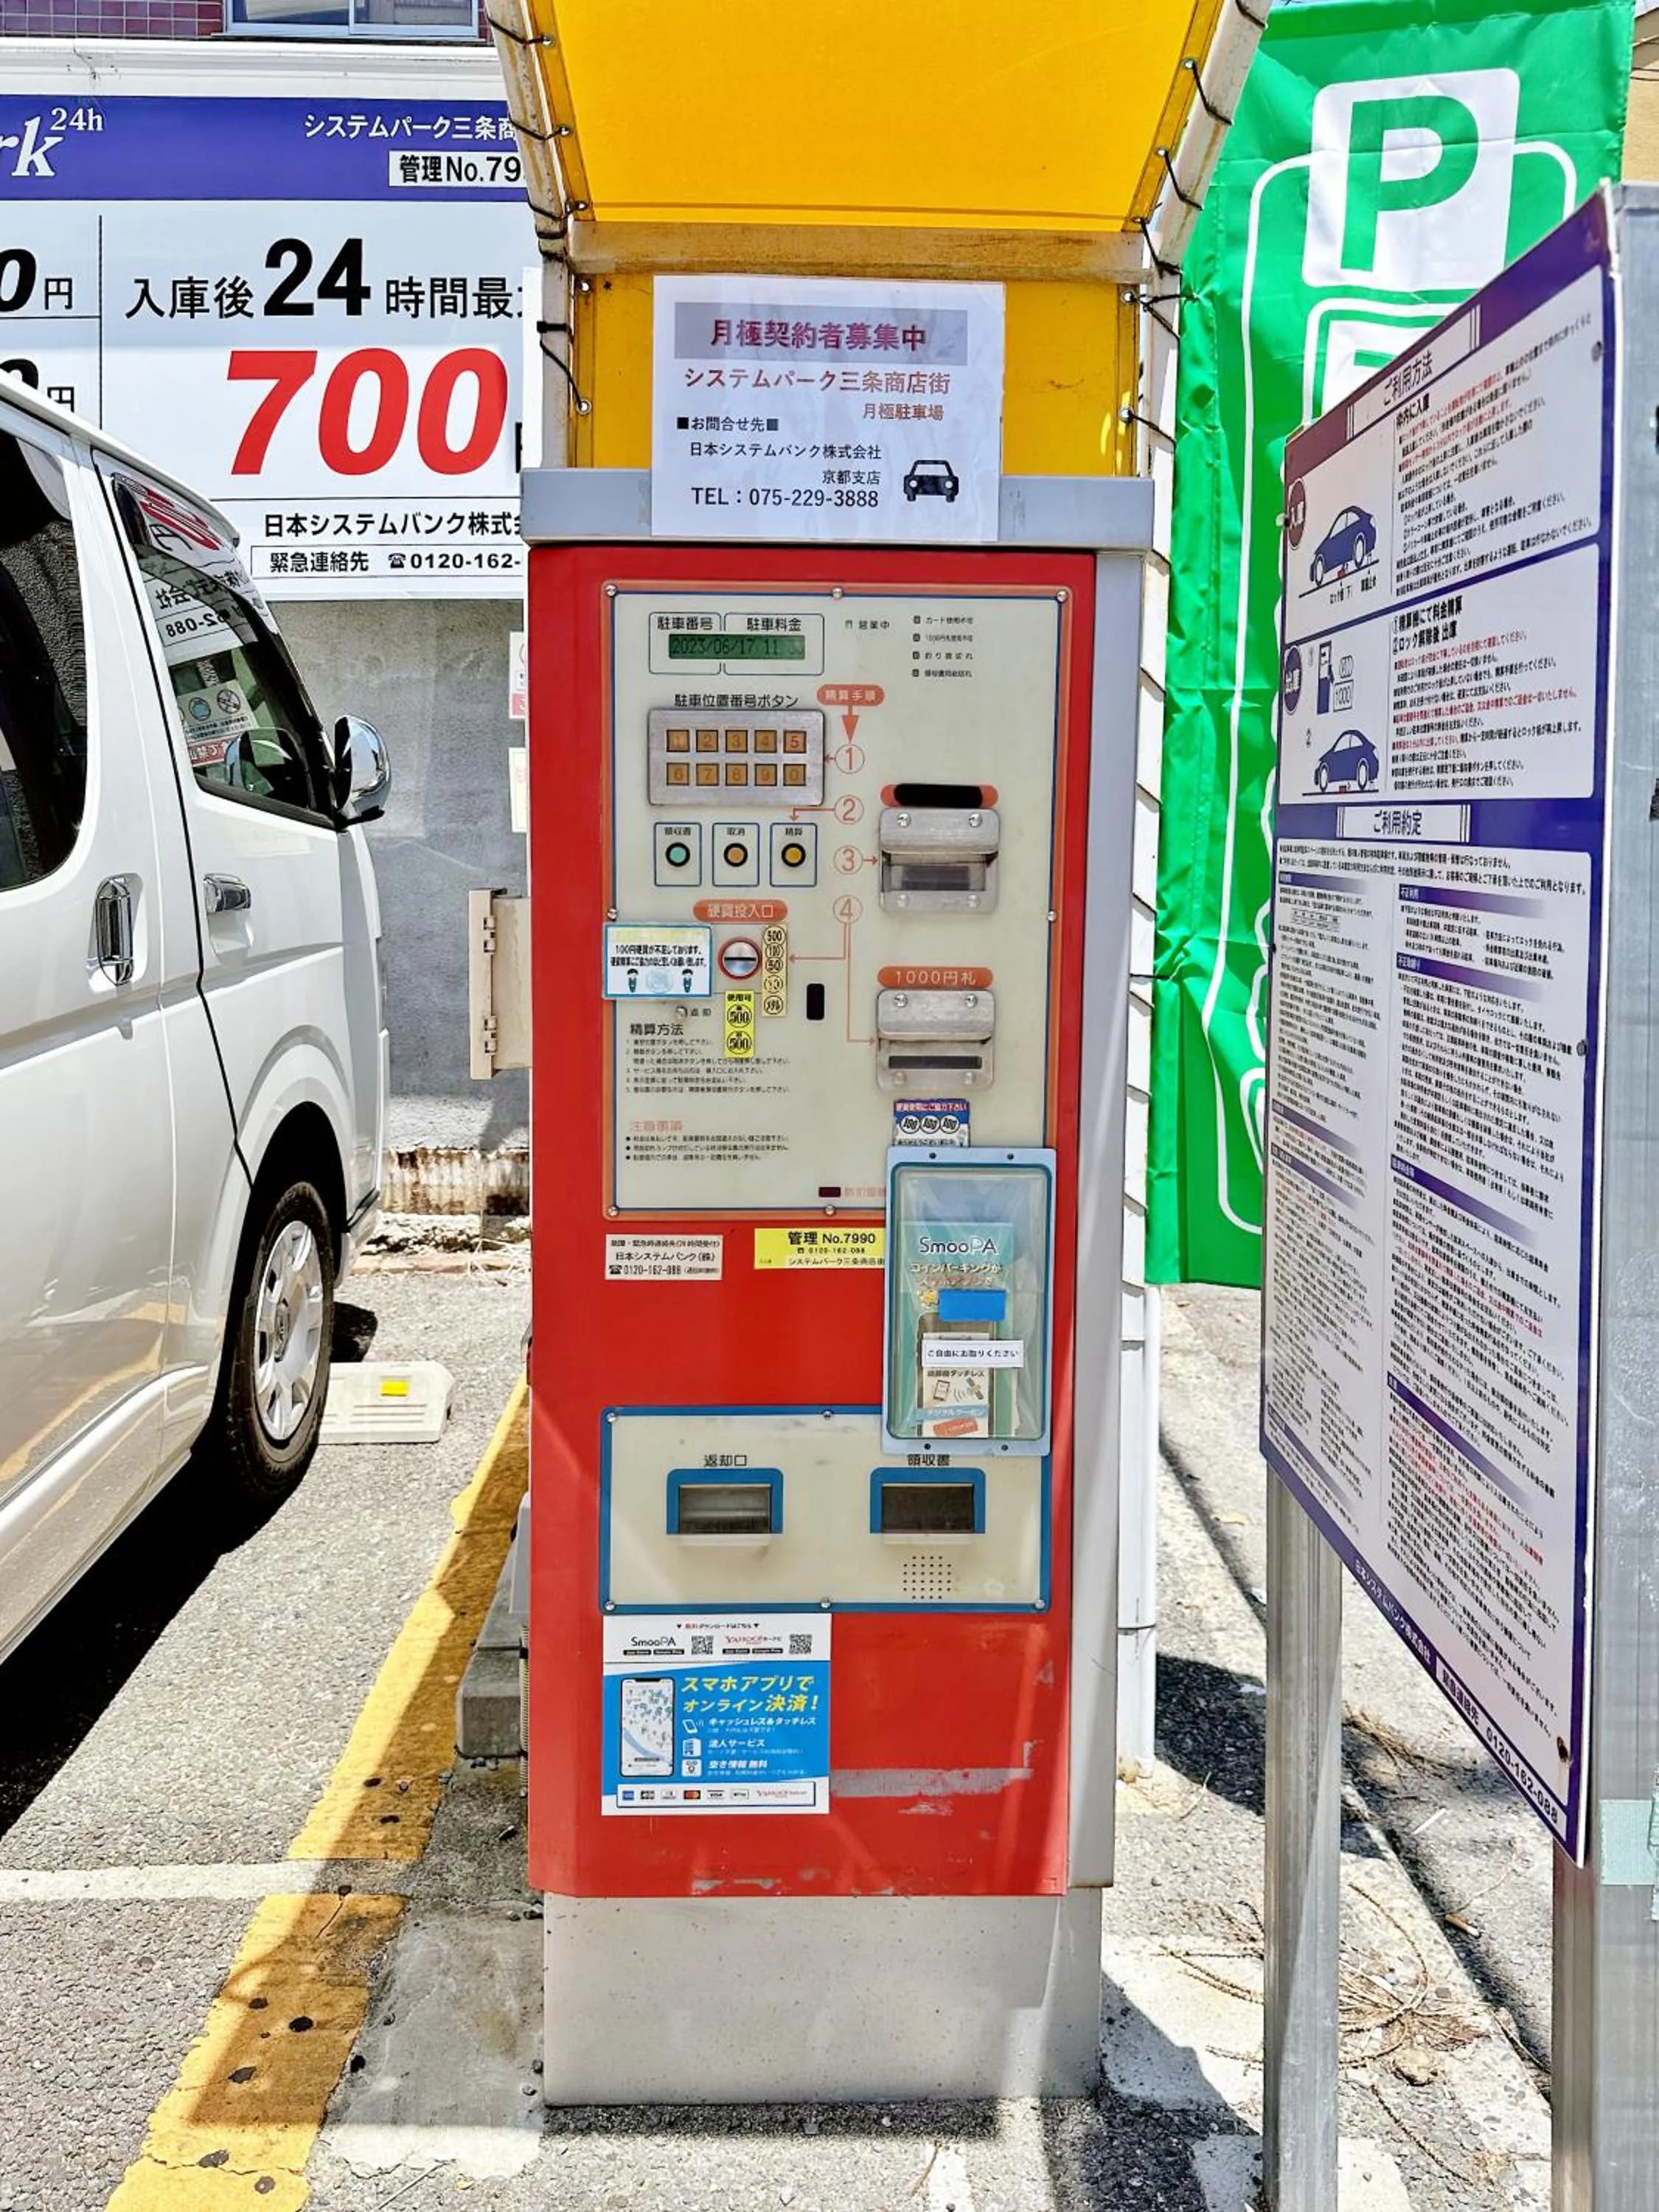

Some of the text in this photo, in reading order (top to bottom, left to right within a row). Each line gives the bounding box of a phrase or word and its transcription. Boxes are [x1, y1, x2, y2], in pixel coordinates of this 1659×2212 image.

[50, 108, 103, 132] 24h
[1340, 94, 1479, 273] P
[709, 319, 927, 353] 月極契約者募集中
[685, 368, 950, 395] システムパーク三条商店街
[1382, 346, 1433, 411] ご利用方法
[226, 347, 508, 476] 700
[863, 403, 945, 421] 月極駐車場
[690, 442, 882, 460] 日本システムバンク株式会社
[822, 470, 881, 485] 京都支店
[270, 552, 369, 573] 緊急連絡先
[674, 693, 799, 708] 駐車位置番号ボタン
[1373, 808, 1422, 838] ご利用約定
[896, 970, 975, 986] 1000円札
[788, 1231, 875, 1245] 管理 No.7990
[919, 1237, 997, 1255] SmooPA
[631, 1637, 676, 1646] SmooPA
[681, 1676, 814, 1693] スマホアプリで
[708, 1739, 765, 1747] 法人サービス
[1486, 1725, 1559, 1825] 0120-162-088
